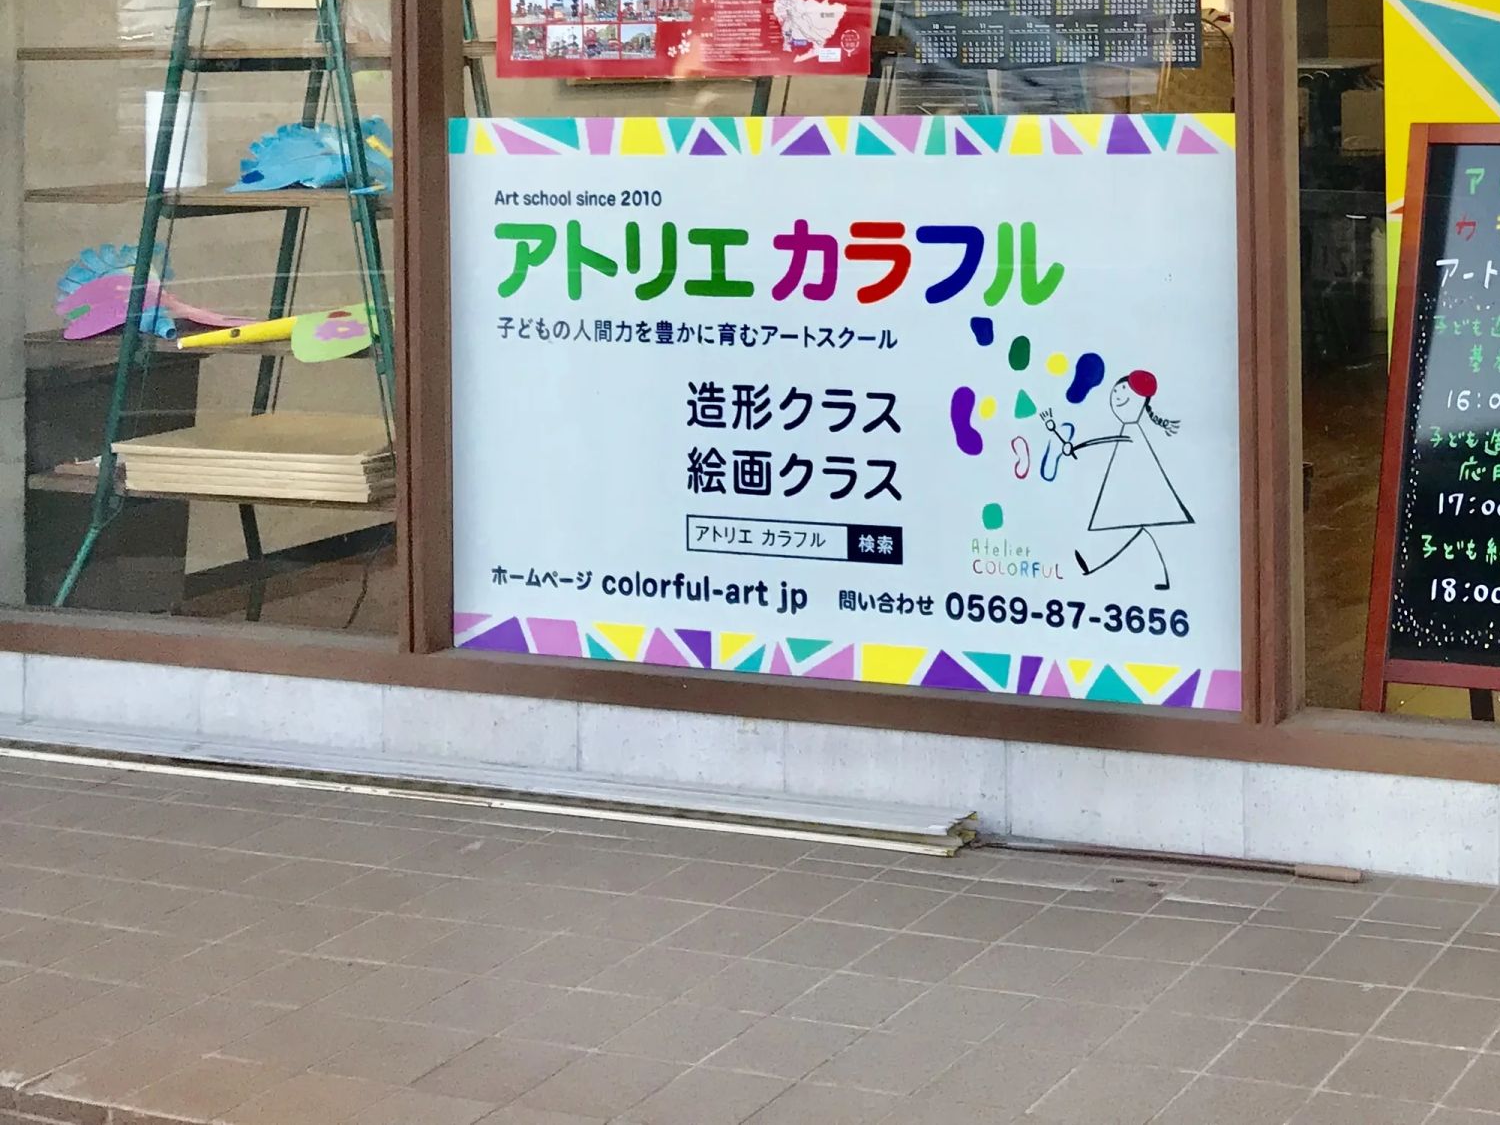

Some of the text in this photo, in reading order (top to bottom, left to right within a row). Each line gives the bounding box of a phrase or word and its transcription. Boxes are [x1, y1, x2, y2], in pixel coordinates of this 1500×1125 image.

[494, 190, 662, 207] Art school since 2010
[494, 218, 1065, 307] アトリエ カラフル
[497, 316, 898, 350] 子どもの人間力を豊かに育むアートスクール
[687, 381, 902, 434] 造形クラス
[687, 446, 903, 501] 絵画クラス
[695, 524, 827, 549] アトリエ カラフル
[857, 533, 894, 555] 検索
[971, 538, 1032, 558] Atelier
[491, 565, 593, 591] ホームページ
[972, 559, 1064, 580] COLORFUL
[839, 589, 1190, 638] 問い合わせ 0569-87-3656
